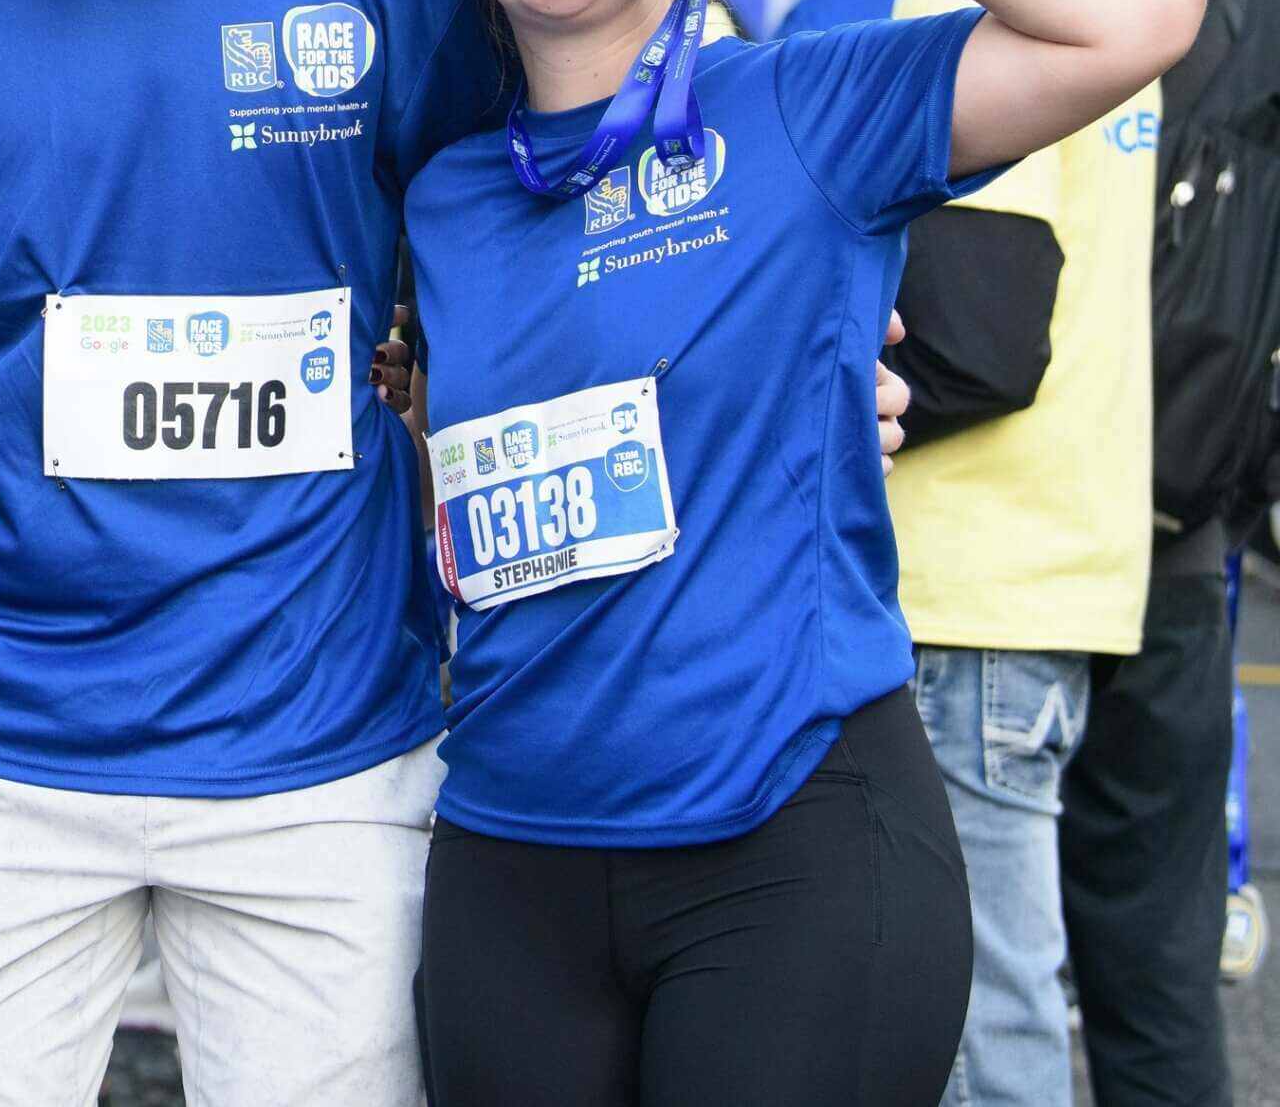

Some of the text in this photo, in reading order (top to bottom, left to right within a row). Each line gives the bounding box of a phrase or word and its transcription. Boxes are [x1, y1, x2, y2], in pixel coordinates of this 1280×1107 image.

[295, 22, 354, 50] RACE
[298, 49, 355, 65] FOR THE
[230, 70, 272, 87] RBC
[298, 64, 356, 90] KIDS
[229, 101, 369, 118] Supporting youth mental health at
[261, 119, 364, 147] Sunnybrook
[650, 172, 679, 193] FOR
[680, 163, 706, 183] THE
[650, 178, 708, 212] KIDS
[589, 208, 627, 232] RBC
[628, 228, 654, 242] youth
[656, 217, 685, 233] mental
[687, 209, 717, 223] health
[719, 206, 729, 216] at
[604, 225, 730, 274] Sunnybrook
[80, 314, 131, 333] 2023
[190, 318, 223, 334] RACE
[310, 317, 332, 336] 5K
[149, 342, 172, 352] RBC
[190, 332, 223, 343] FOR THE
[190, 340, 223, 353] KIDS
[305, 366, 332, 382] RBC
[122, 379, 287, 451] 05716
[612, 409, 638, 431] 5K
[504, 427, 533, 447] RACE
[439, 443, 466, 468] 2023
[506, 443, 519, 456] FOR
[506, 449, 534, 469] KIDS
[478, 461, 495, 474] RBC
[613, 460, 644, 478] RBC
[467, 465, 597, 567] 03138
[493, 547, 578, 589] STEPHANIE
